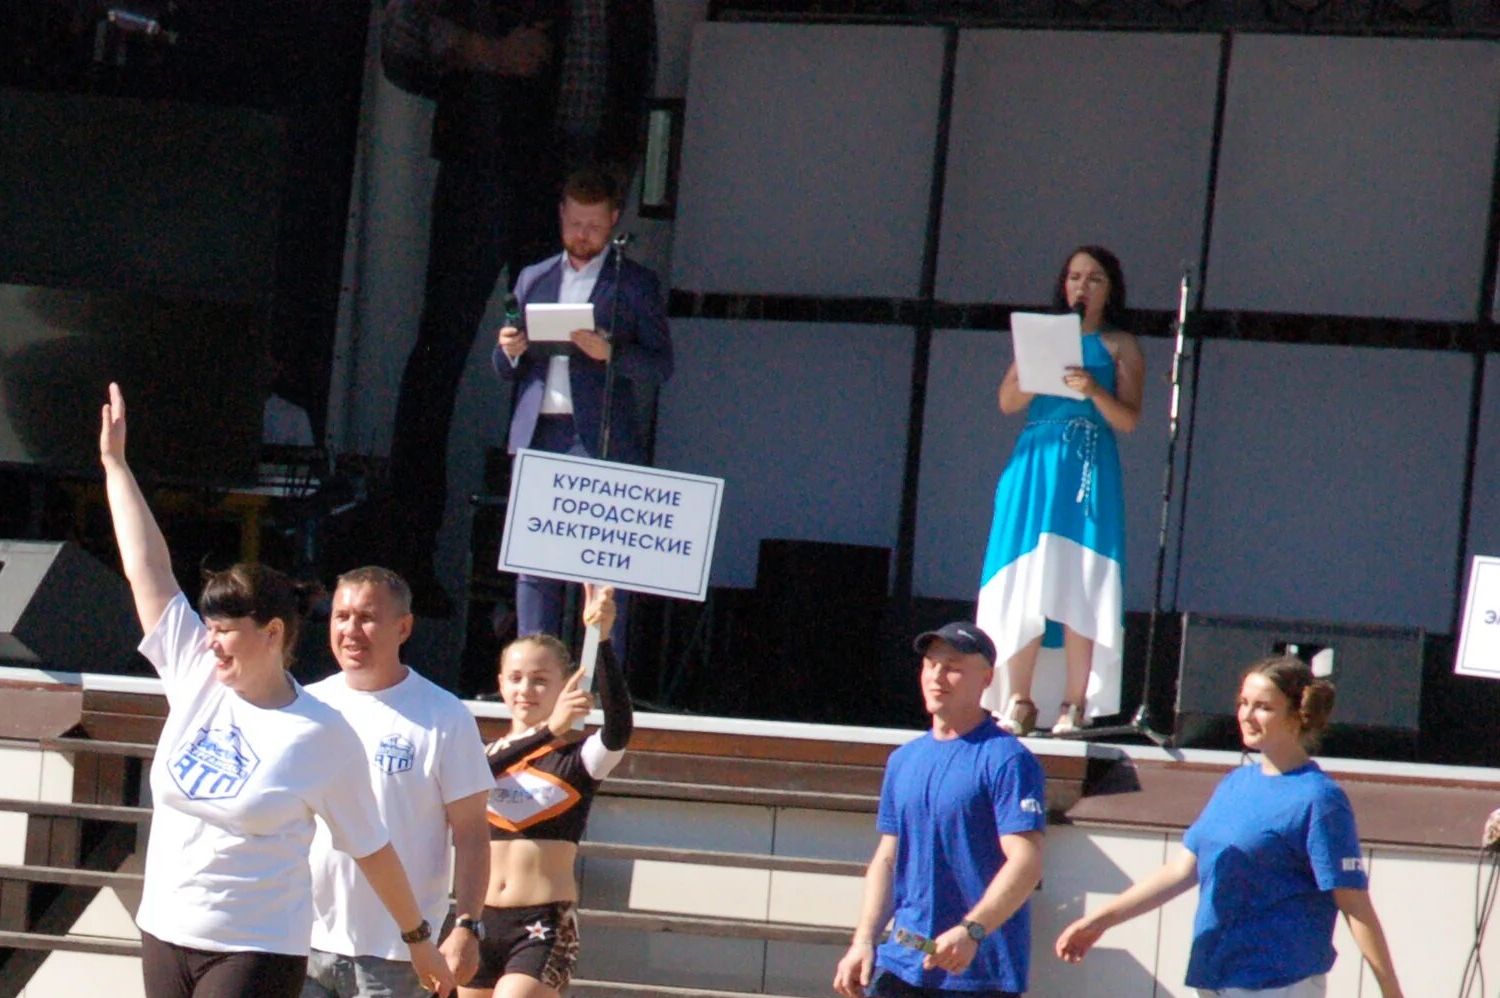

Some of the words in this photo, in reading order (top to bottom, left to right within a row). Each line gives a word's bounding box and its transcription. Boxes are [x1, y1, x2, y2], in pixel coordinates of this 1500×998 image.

[552, 472, 682, 507] КУРГАНСКИЕ
[552, 497, 675, 529] ГОРОДСКИЕ
[527, 517, 693, 557] ЭЛЕКТРИЧЕСКИЕ
[580, 549, 631, 570] СЕТИ
[173, 754, 239, 796] АТП
